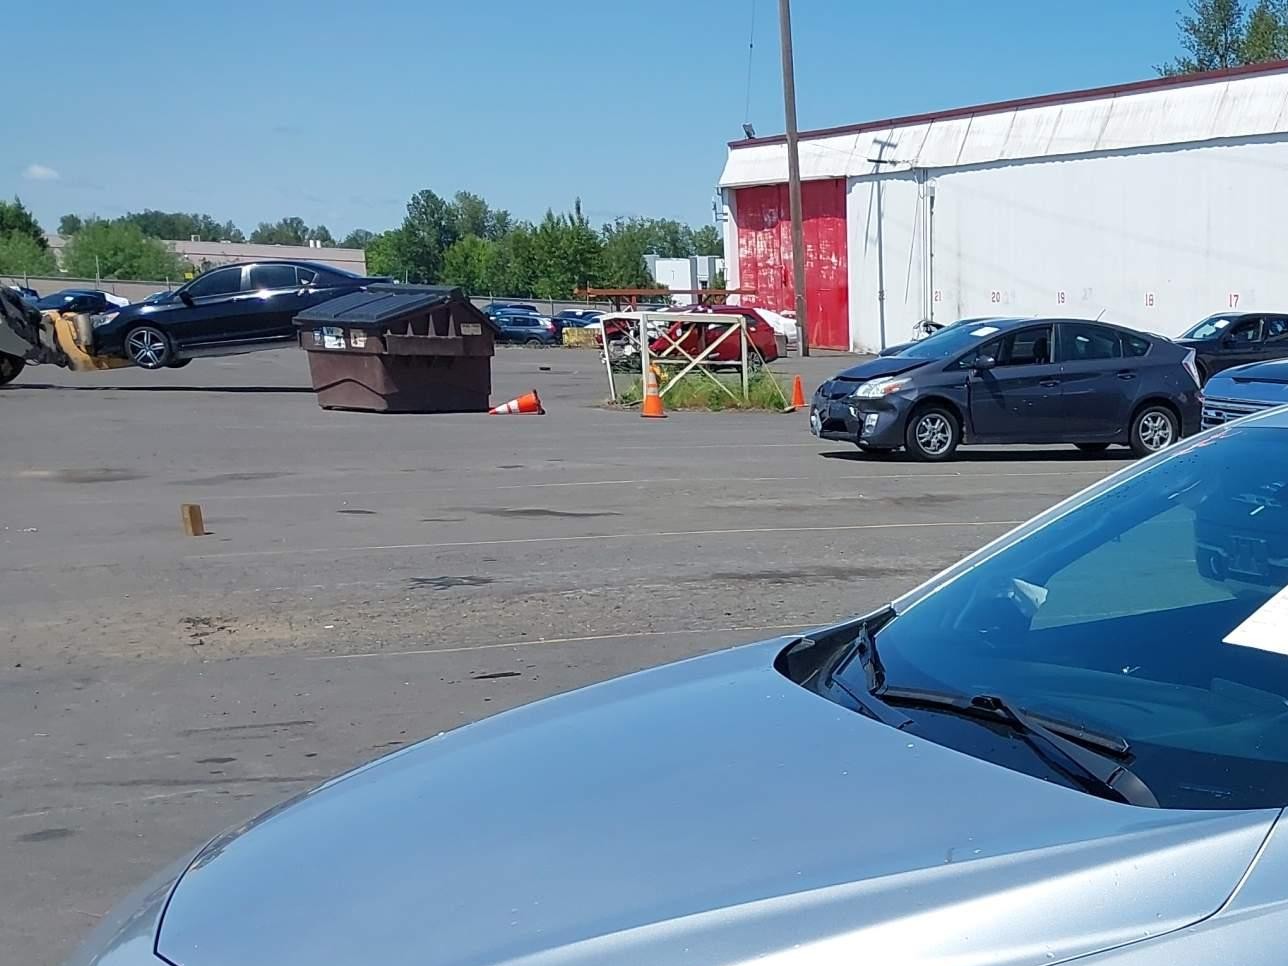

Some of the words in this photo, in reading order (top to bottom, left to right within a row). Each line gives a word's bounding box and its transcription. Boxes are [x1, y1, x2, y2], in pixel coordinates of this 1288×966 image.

[934, 290, 942, 302] 21
[991, 291, 1001, 303] 20
[1057, 291, 1066, 304] 19
[1145, 293, 1154, 306] 18
[1229, 294, 1239, 308] 17
